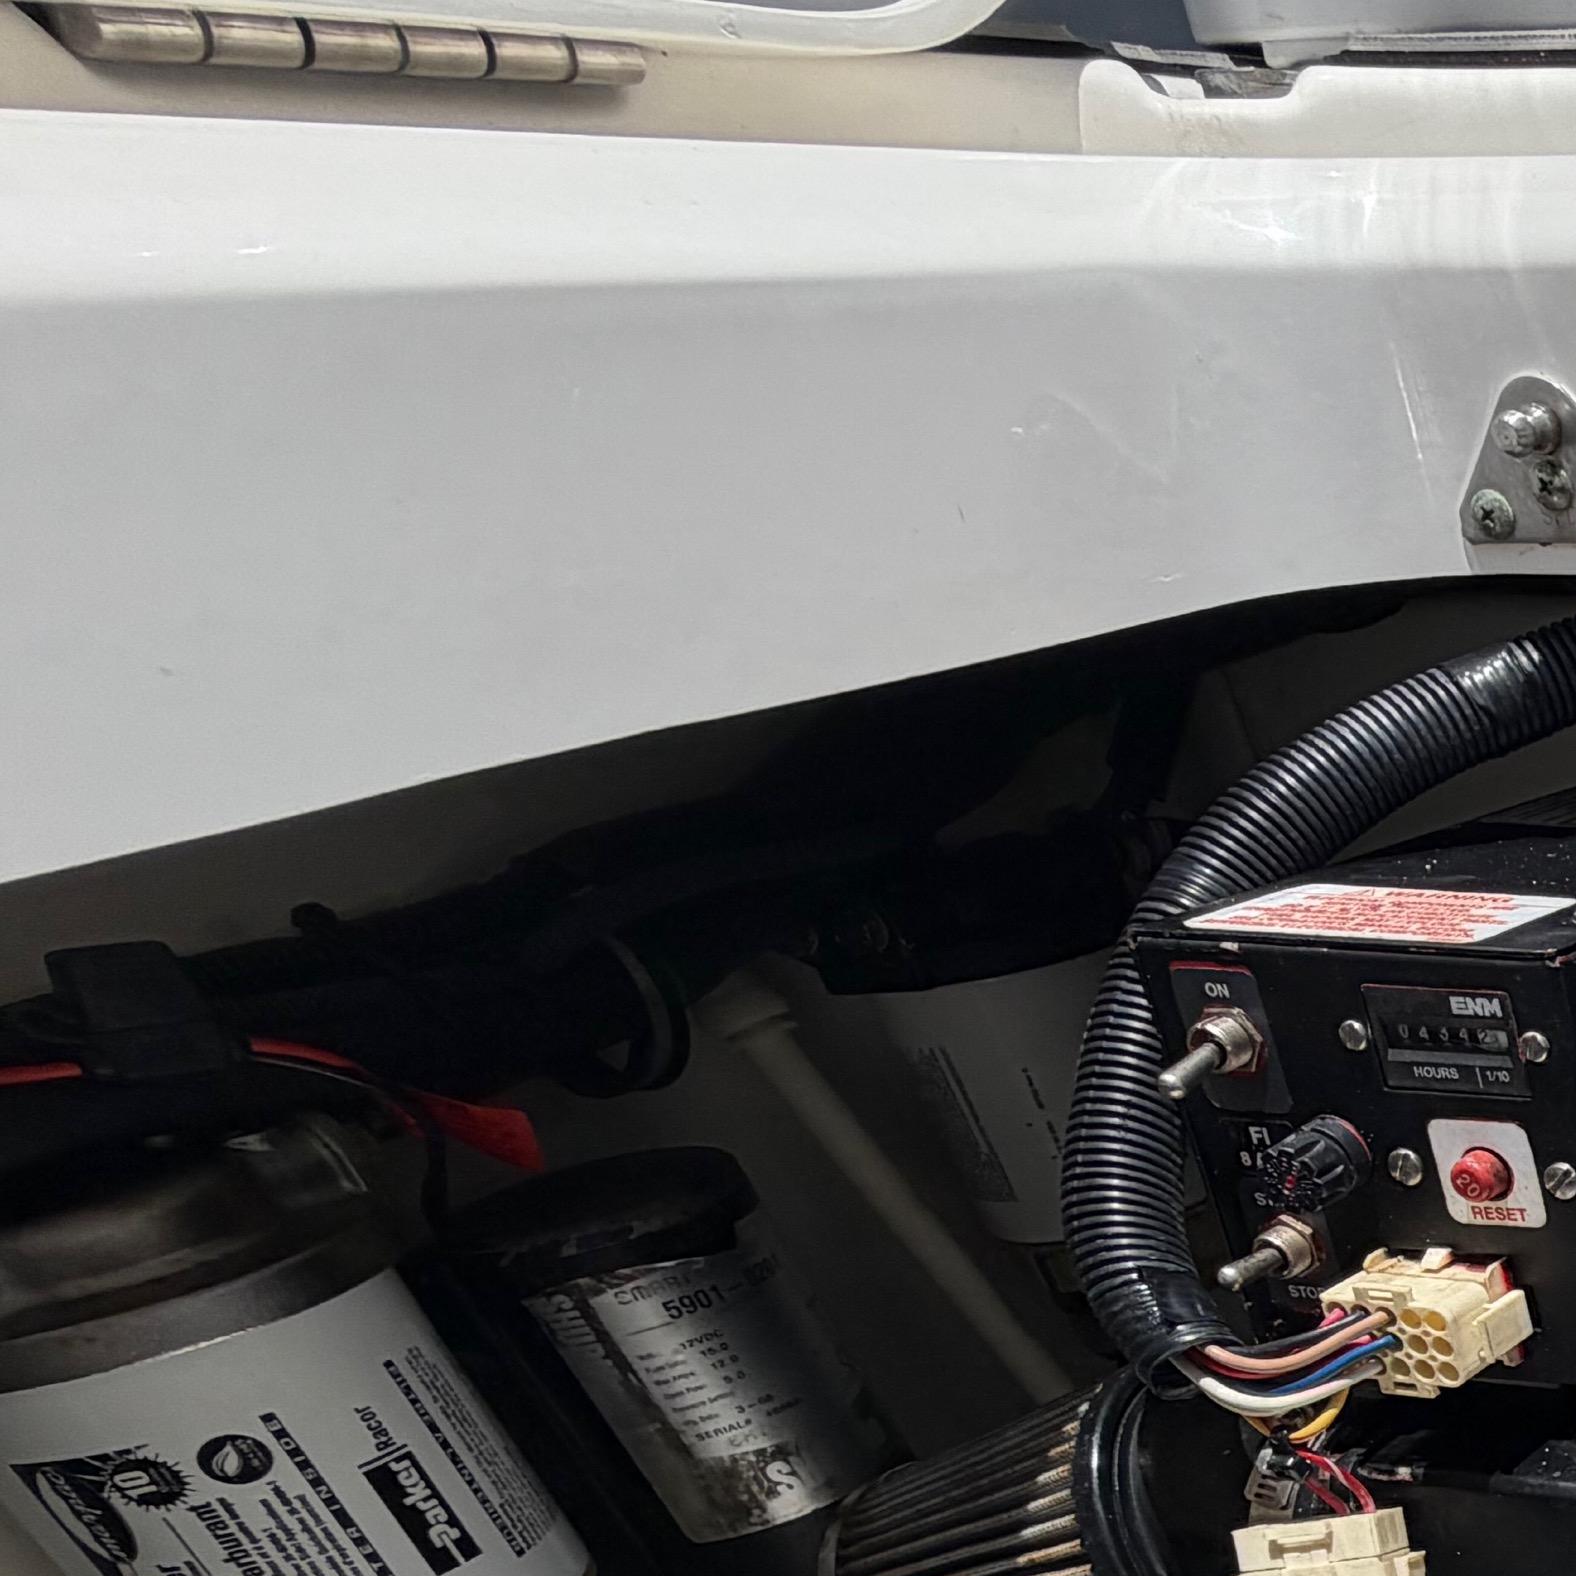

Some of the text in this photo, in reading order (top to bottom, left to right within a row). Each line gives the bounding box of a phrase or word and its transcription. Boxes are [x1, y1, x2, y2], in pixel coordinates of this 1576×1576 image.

[1204, 981, 1231, 999] ON
[1448, 995, 1503, 1018] ENM
[1413, 1065, 1511, 1083] HOURS 1/10
[1455, 1173, 1481, 1198] 20
[1470, 1205, 1527, 1223] RESET
[1288, 1284, 1323, 1300] STO
[261, 1419, 345, 1510] INSIDE
[352, 1401, 463, 1550] Parker Racor
[110, 1467, 159, 1499] 10
